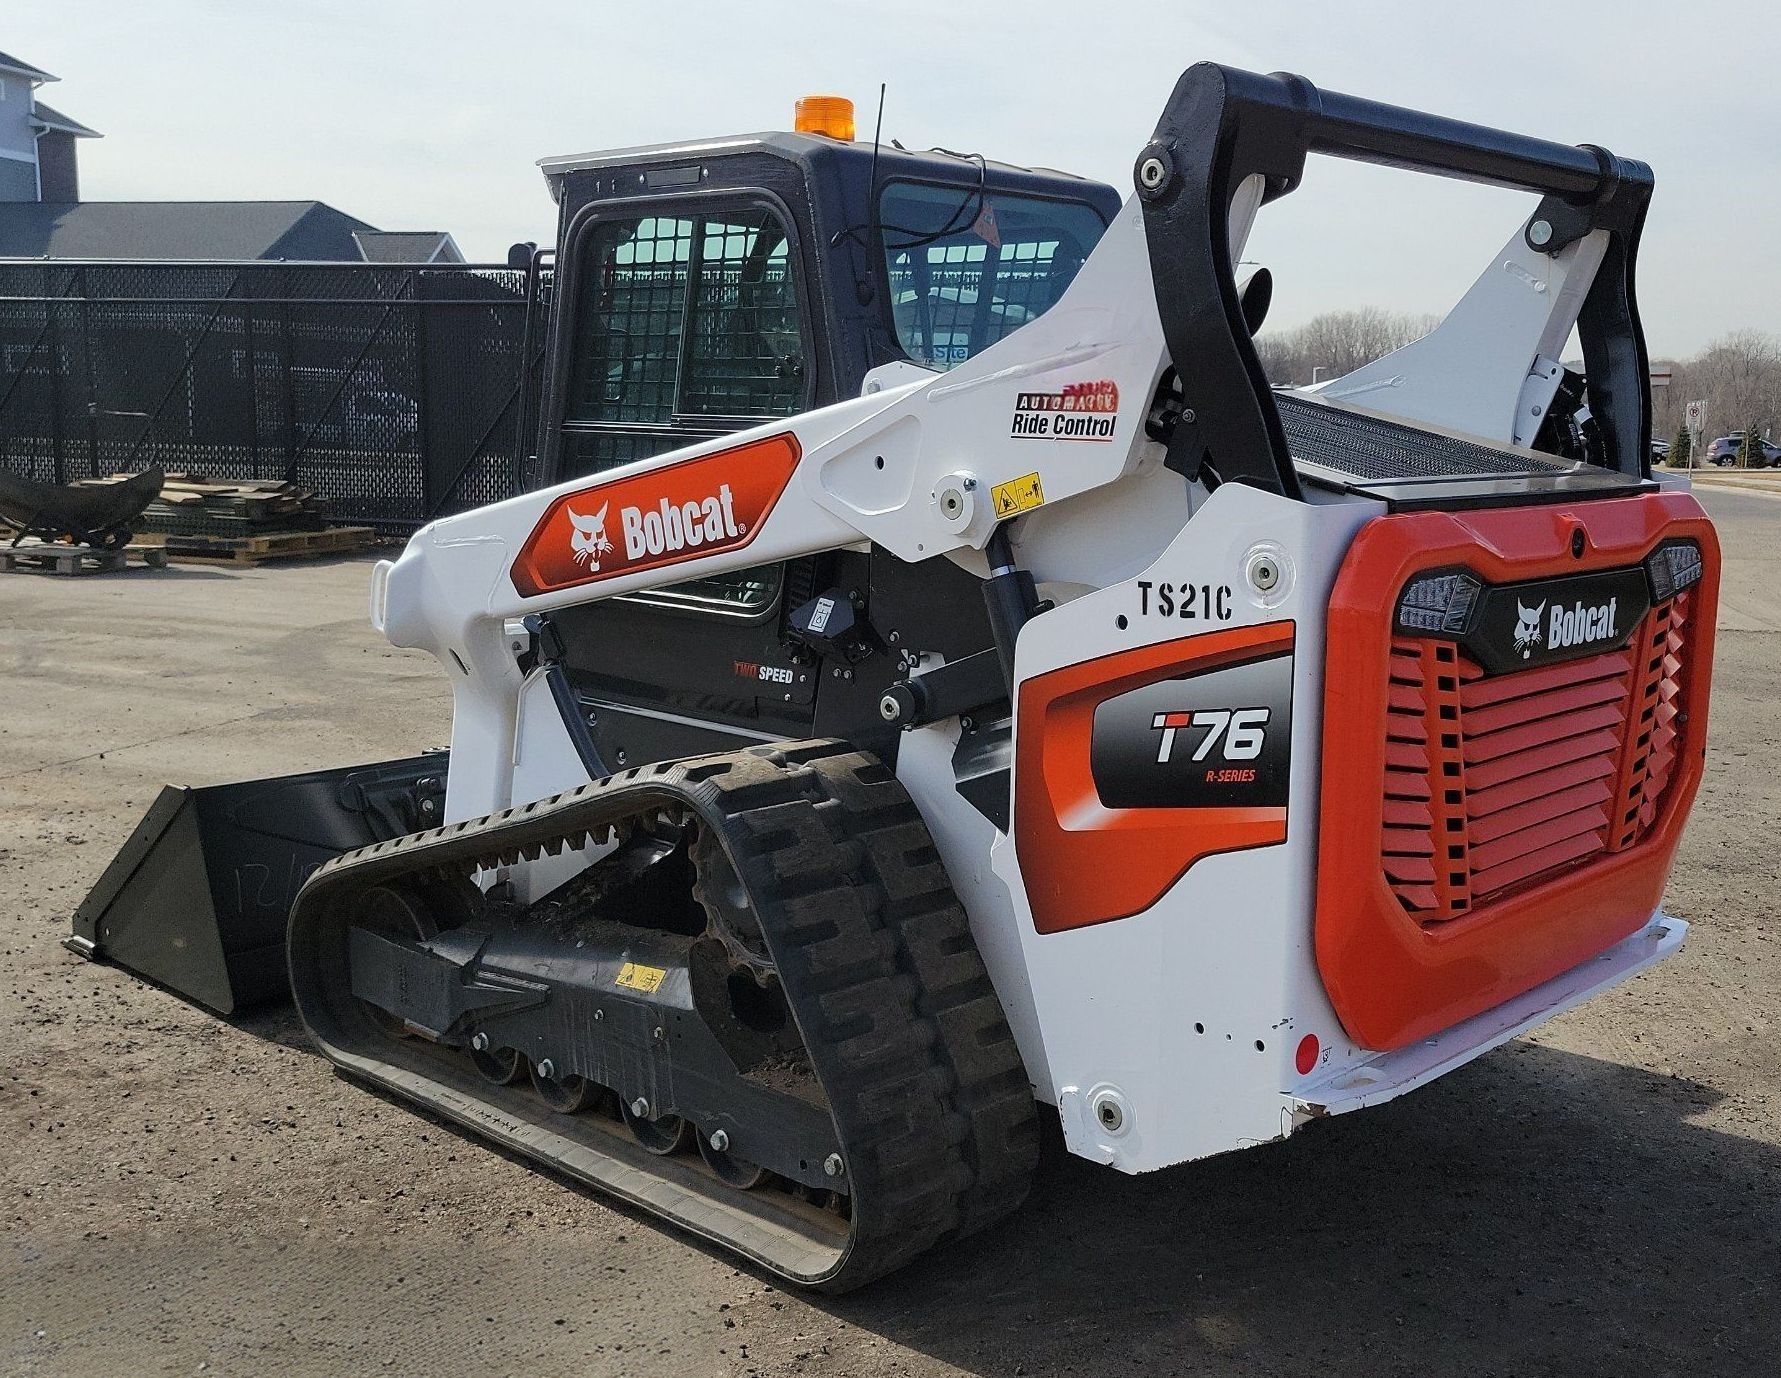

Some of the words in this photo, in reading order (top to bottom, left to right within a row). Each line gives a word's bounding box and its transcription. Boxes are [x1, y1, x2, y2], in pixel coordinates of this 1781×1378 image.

[1012, 413, 1048, 434] Ride
[1053, 414, 1117, 437] Control
[1138, 581, 1232, 620] TS21C
[1548, 597, 1617, 650] Bobcat
[1152, 708, 1271, 763] T76
[1206, 769, 1256, 782] R-SERIES
